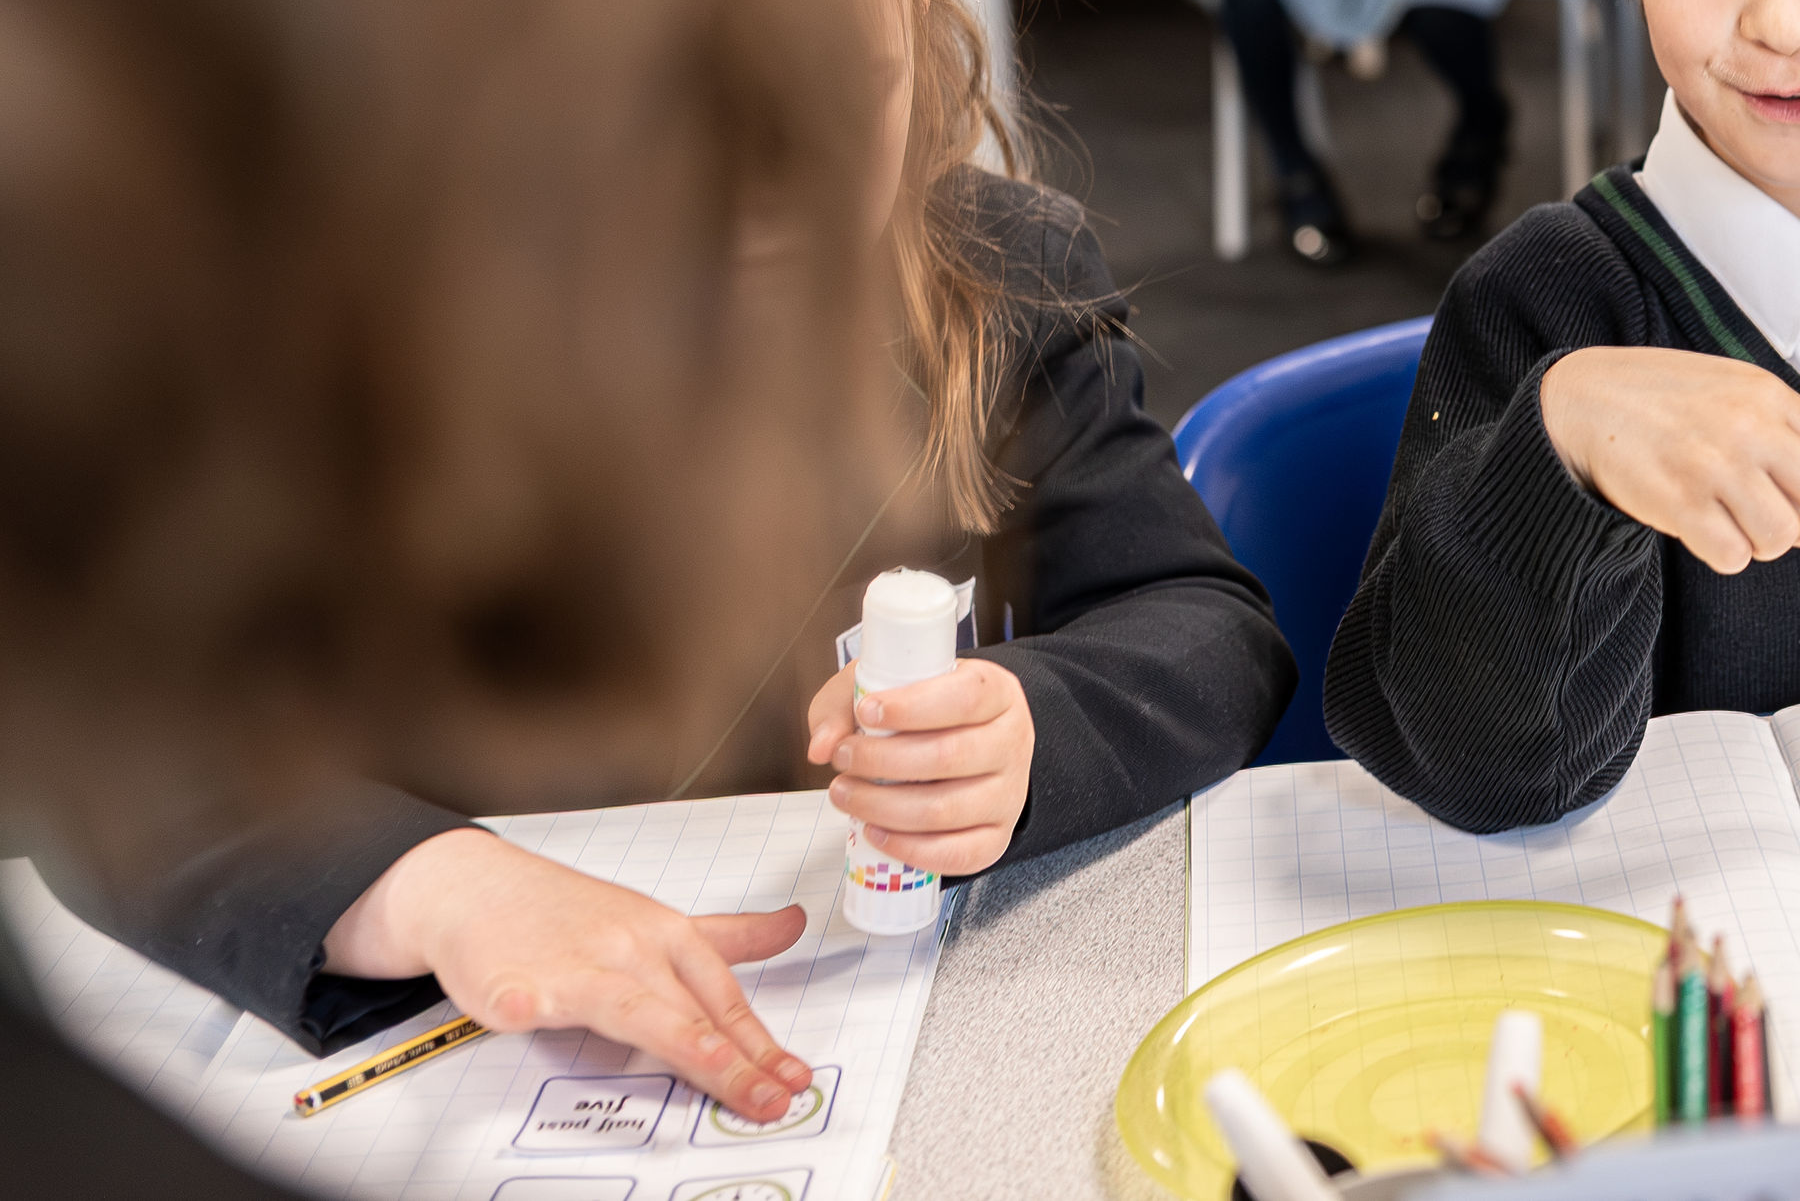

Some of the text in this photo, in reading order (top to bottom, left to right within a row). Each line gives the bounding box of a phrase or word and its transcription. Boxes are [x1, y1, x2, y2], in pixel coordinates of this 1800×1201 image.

[574, 1093, 632, 1114] five
[536, 1117, 646, 1135] half past
